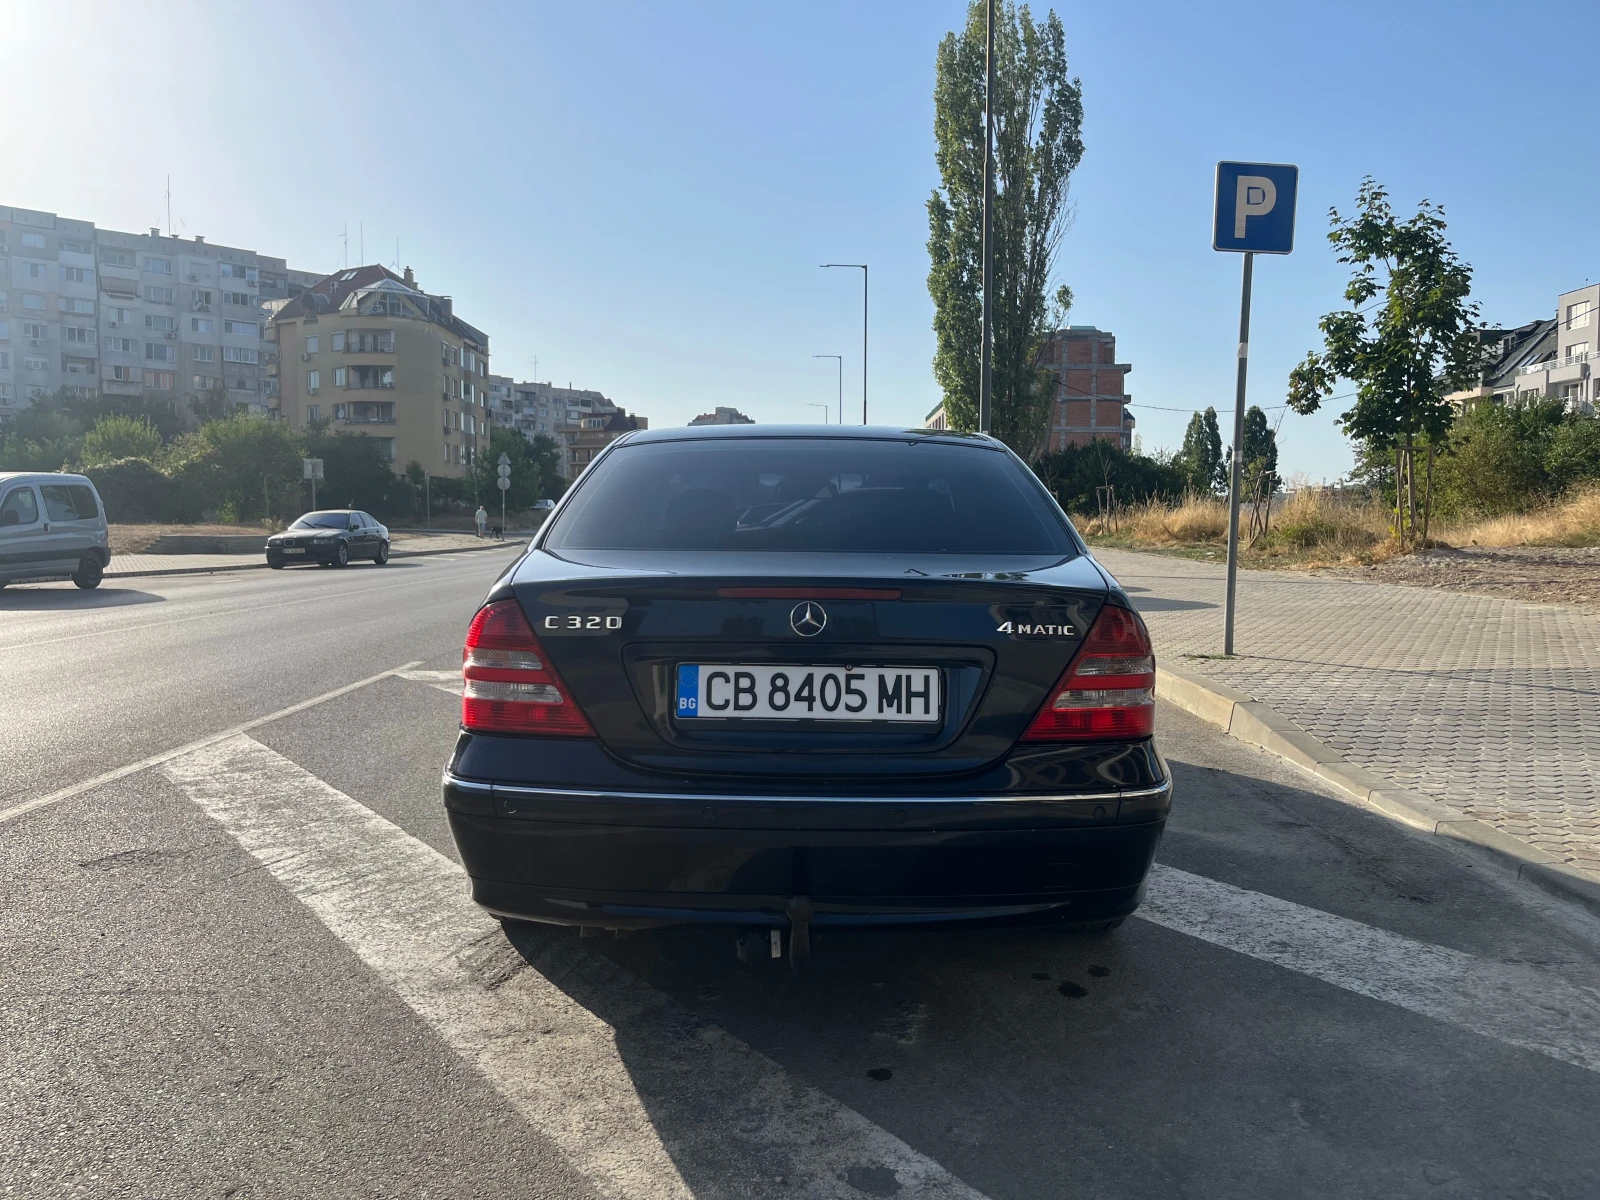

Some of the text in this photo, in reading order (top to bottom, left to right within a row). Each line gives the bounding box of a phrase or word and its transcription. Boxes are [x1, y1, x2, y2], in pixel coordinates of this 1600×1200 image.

[1234, 175, 1277, 239] P
[544, 615, 623, 629] C 320
[679, 697, 697, 710] BG
[706, 671, 930, 715] CB 8405 MH
